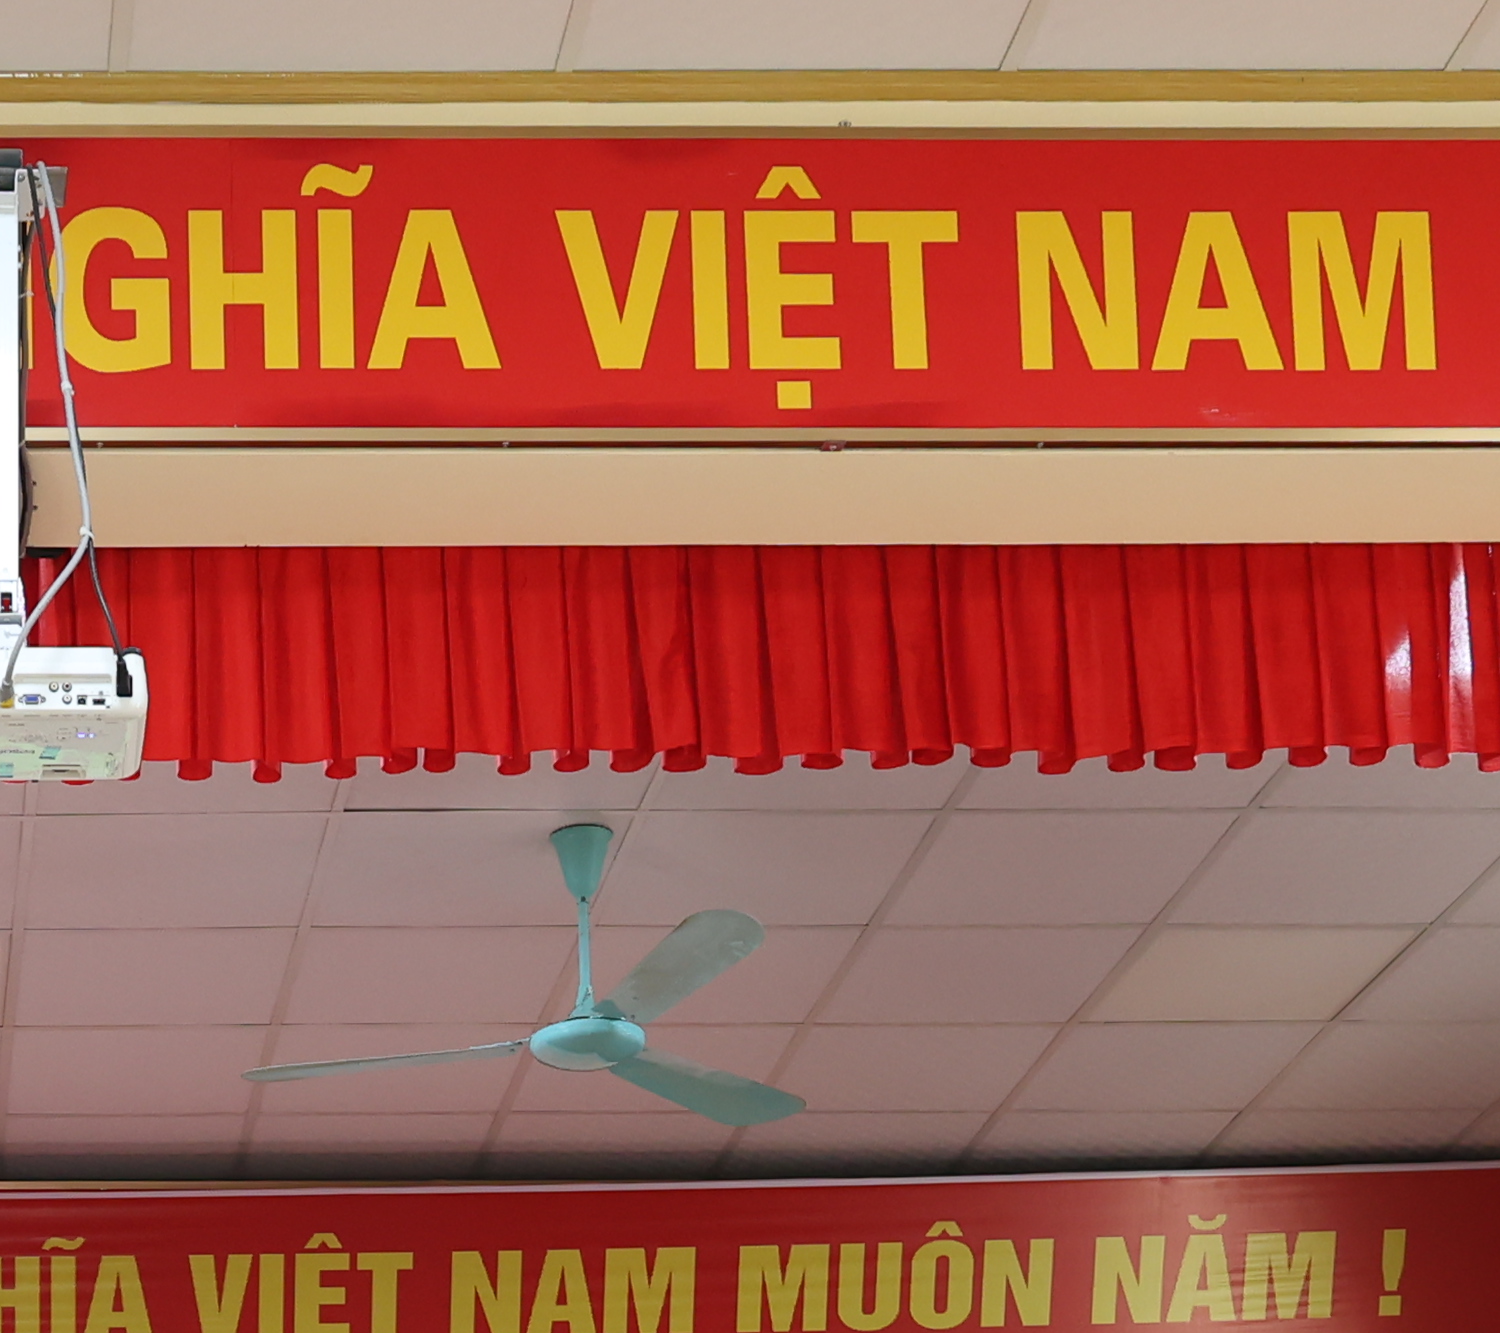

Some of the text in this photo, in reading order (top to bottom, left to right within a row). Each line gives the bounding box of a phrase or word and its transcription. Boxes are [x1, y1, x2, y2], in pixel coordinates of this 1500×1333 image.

[555, 166, 960, 411] VIỆT
[1016, 211, 1438, 373] NAM
[737, 1221, 1056, 1333] MUÔN
[1092, 1214, 1338, 1326] NĂM
[1378, 1229, 1408, 1318] !
